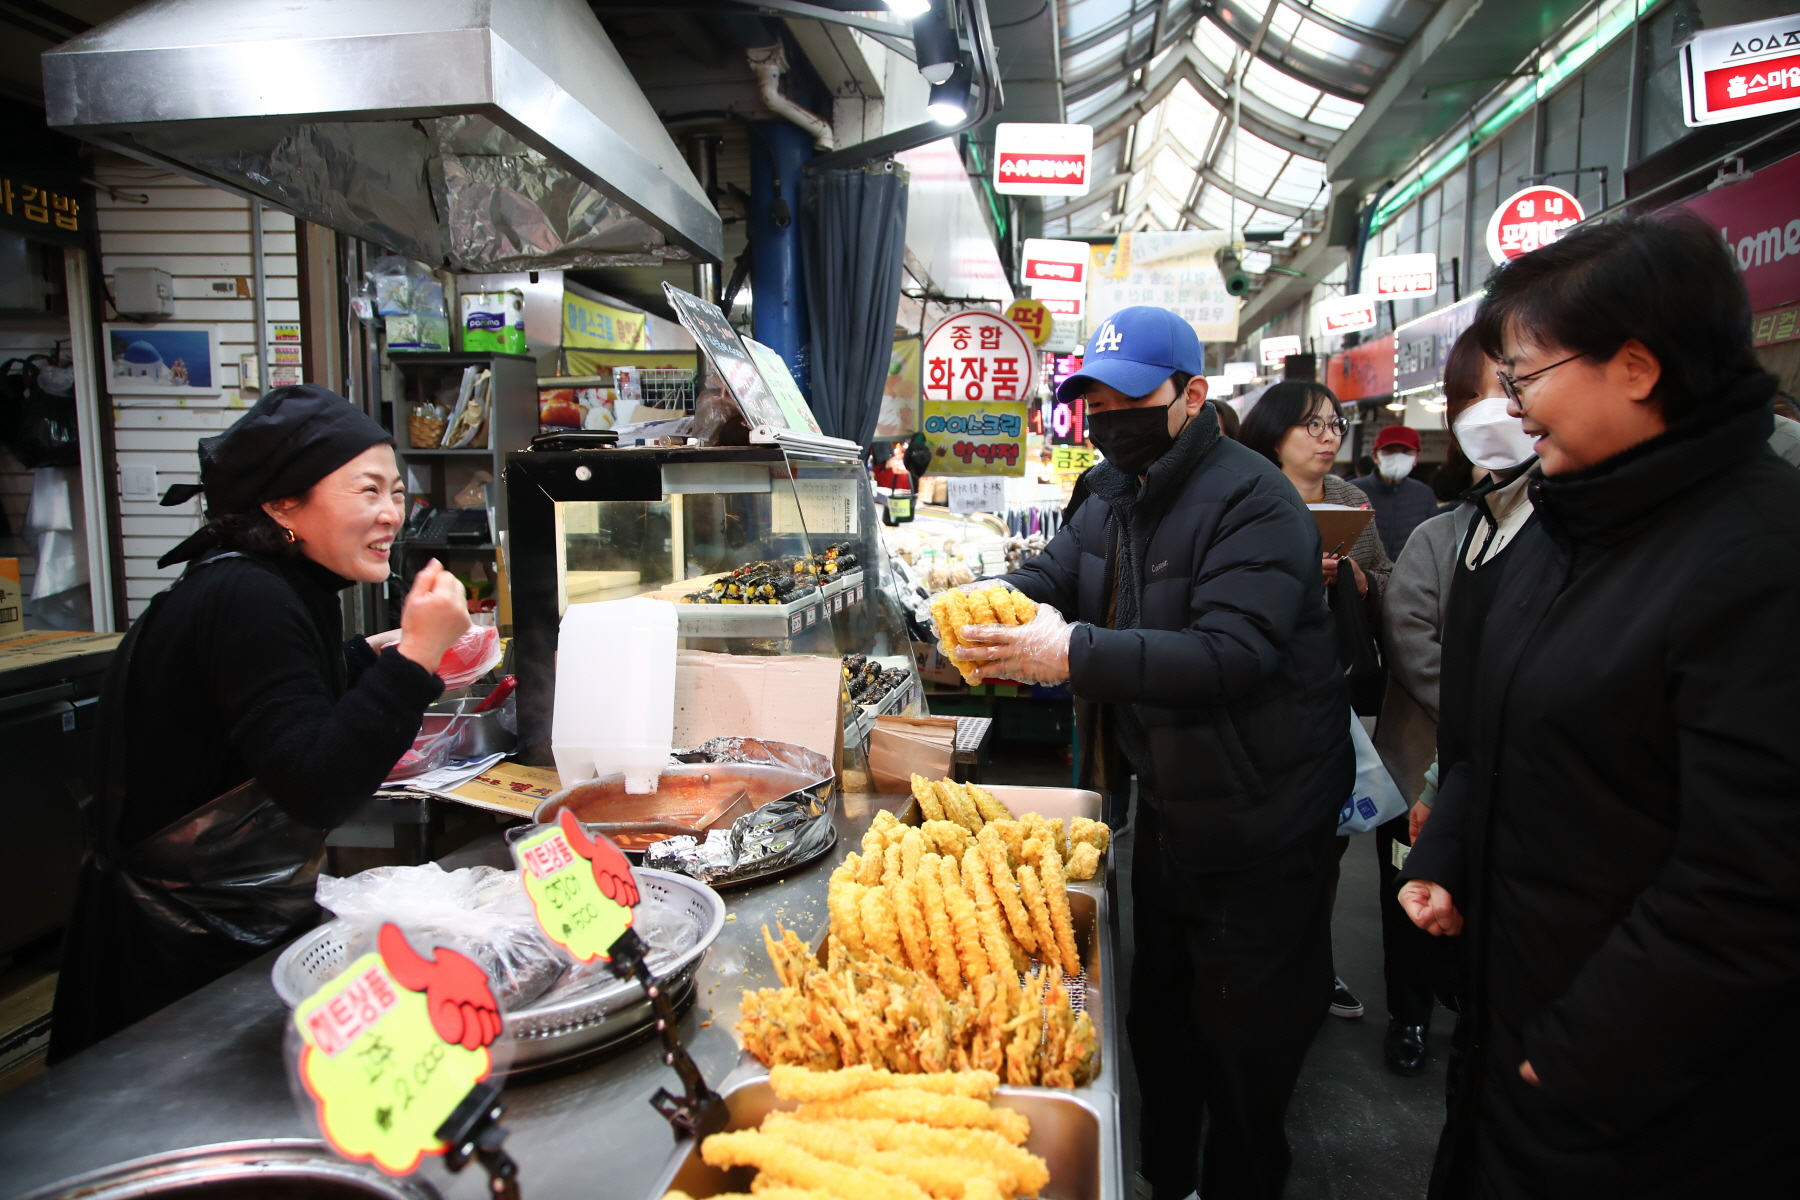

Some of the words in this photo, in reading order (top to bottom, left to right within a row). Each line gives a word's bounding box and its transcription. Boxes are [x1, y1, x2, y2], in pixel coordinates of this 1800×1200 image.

[1722, 219, 1800, 272] ome
[469, 318, 500, 328] paroma
[568, 302, 615, 341] 아이스크림
[1012, 307, 1044, 339] 떡
[950, 325, 1003, 351] 종합
[1095, 320, 1123, 354] LA
[927, 356, 1020, 400] 화장품
[925, 414, 1022, 437] 아이스크림
[953, 440, 1020, 467] 할인점
[1056, 450, 1091, 469] 금조
